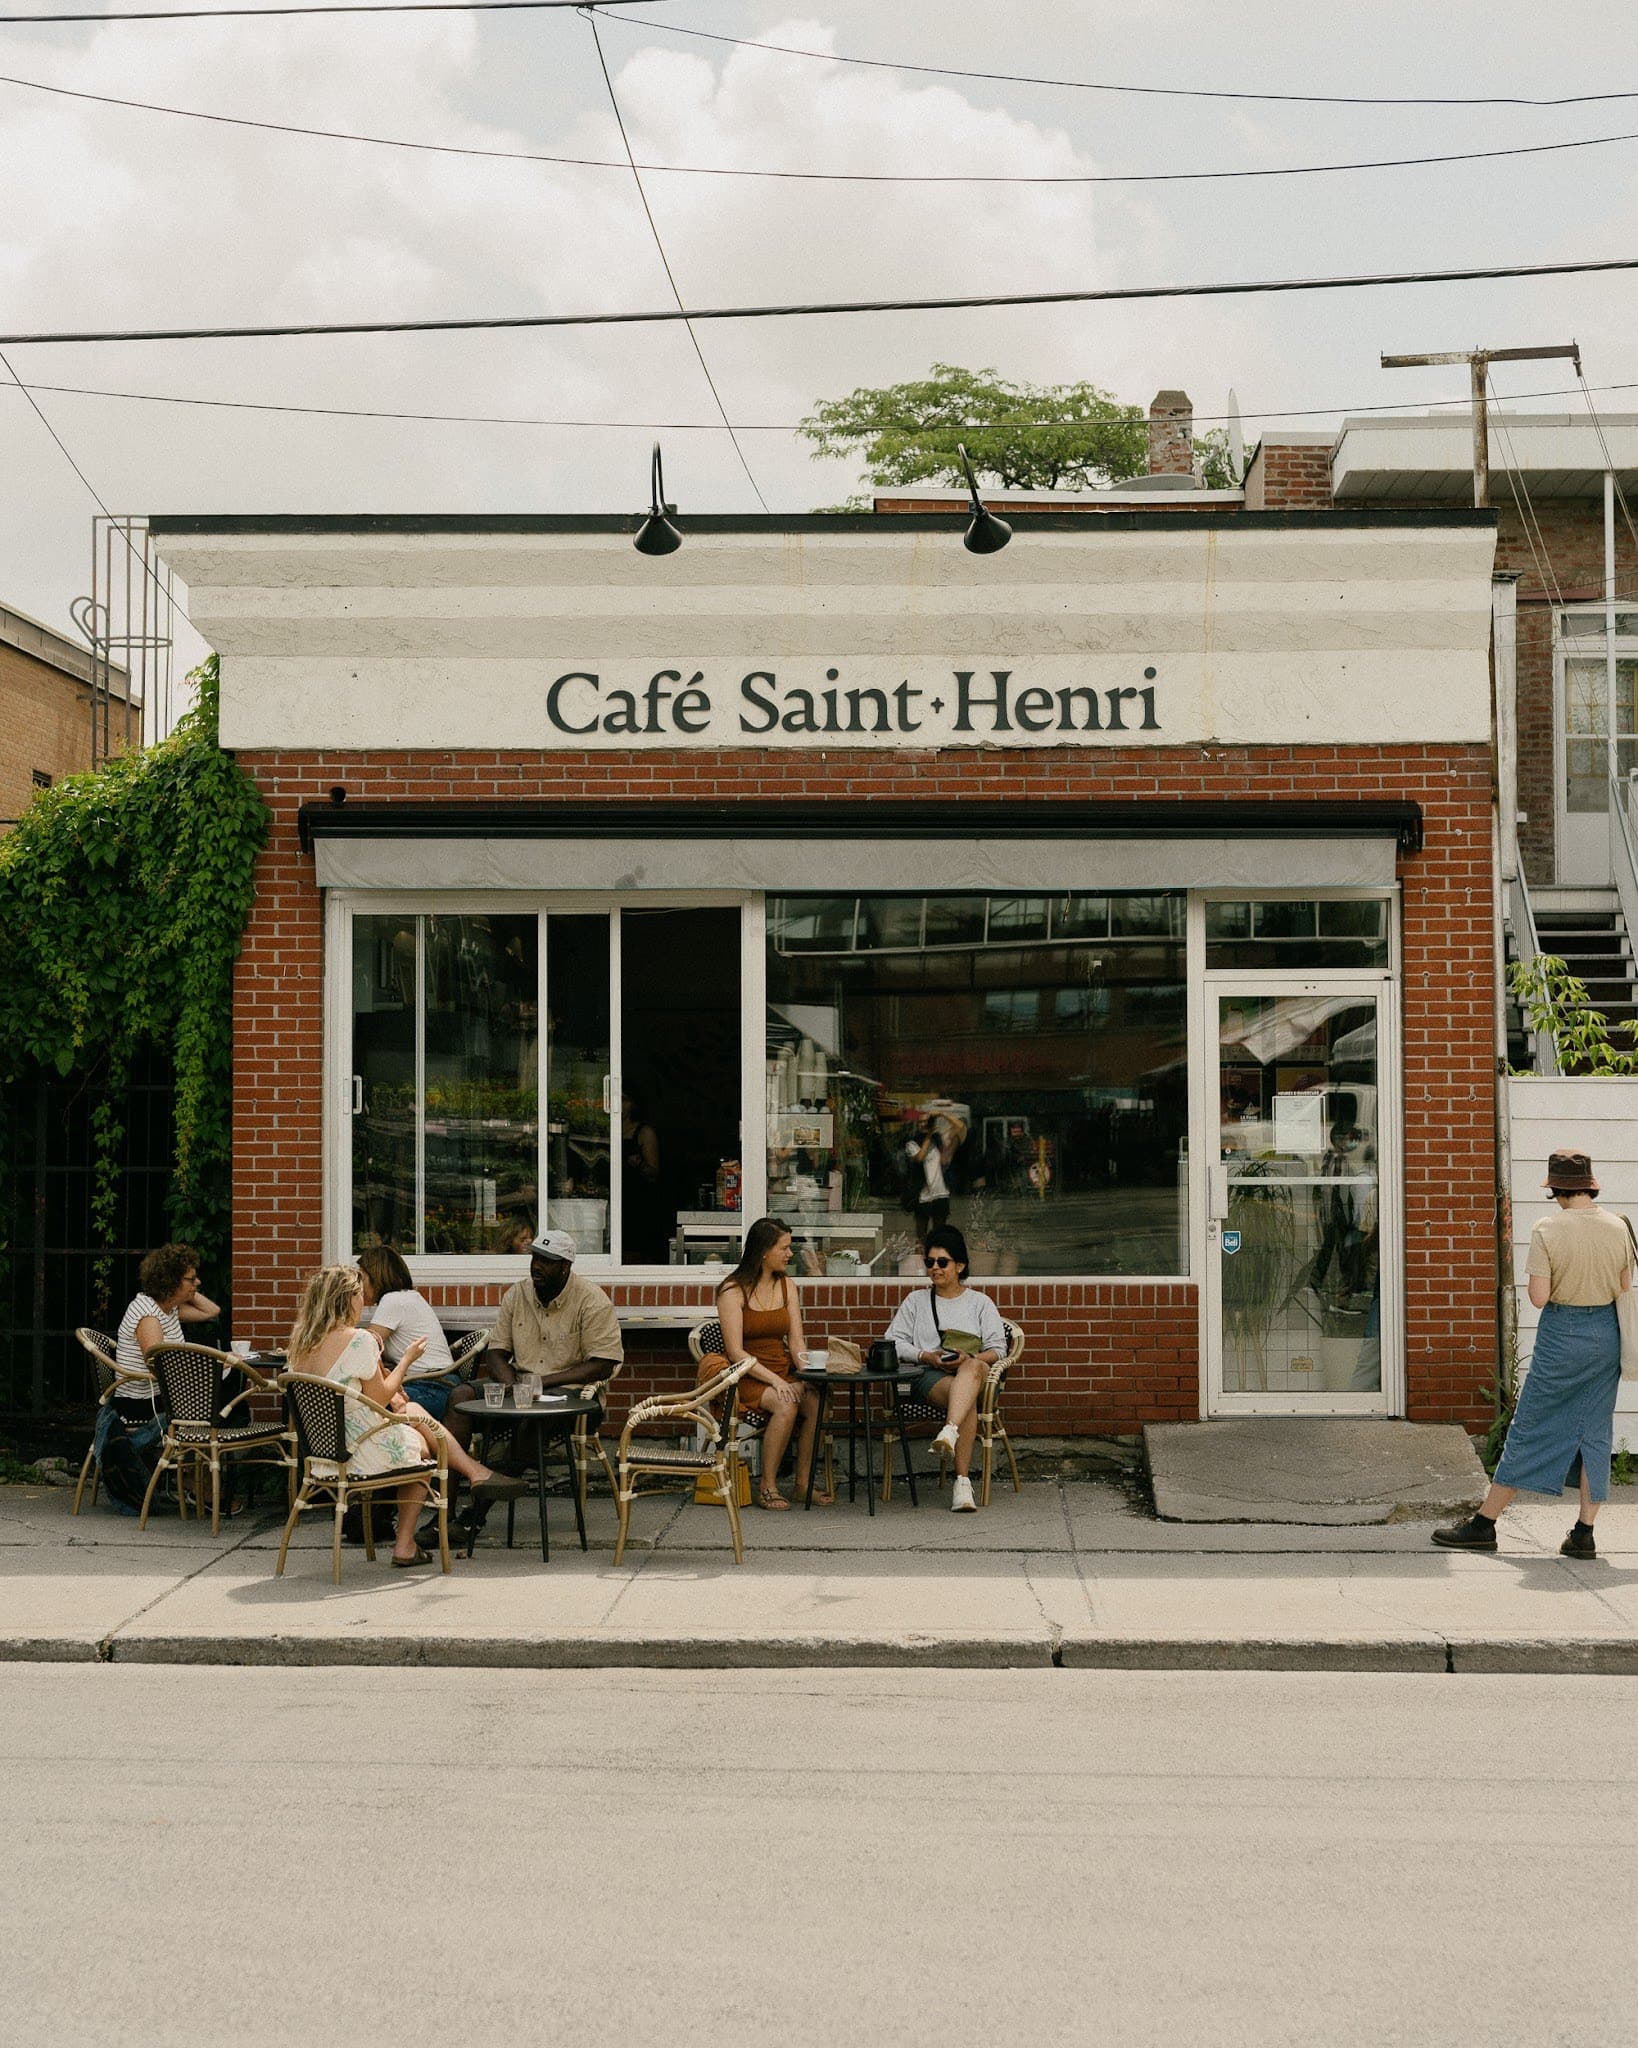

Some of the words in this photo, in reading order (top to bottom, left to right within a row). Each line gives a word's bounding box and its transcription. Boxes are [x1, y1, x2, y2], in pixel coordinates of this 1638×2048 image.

[547, 669, 711, 735] Café
[740, 668, 922, 733] Saint
[952, 667, 1162, 732] Henri
[1225, 1236, 1238, 1247] Bell
